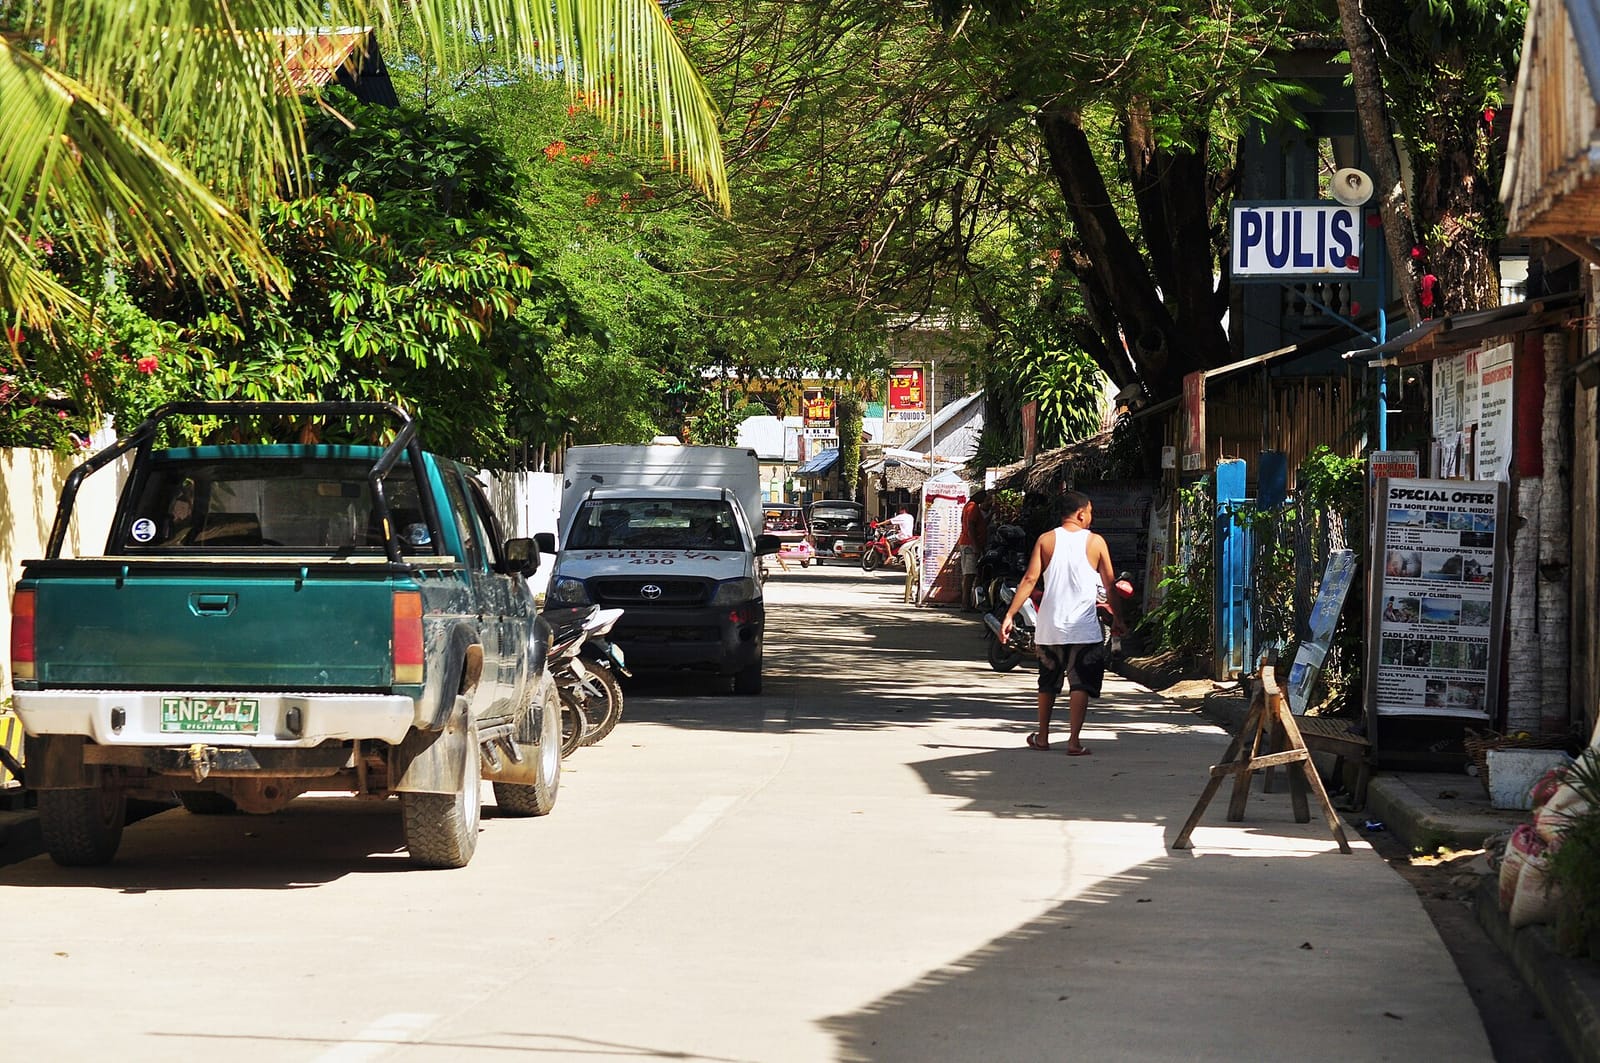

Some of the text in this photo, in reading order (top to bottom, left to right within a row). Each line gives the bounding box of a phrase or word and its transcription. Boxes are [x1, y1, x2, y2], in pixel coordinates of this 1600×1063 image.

[1240, 210, 1353, 269] PULIS
[1389, 488, 1495, 505] SPECIAL OFFER
[1404, 503, 1427, 511] MORE
[1382, 631, 1489, 643] CADLAO ISLAND TREKKING
